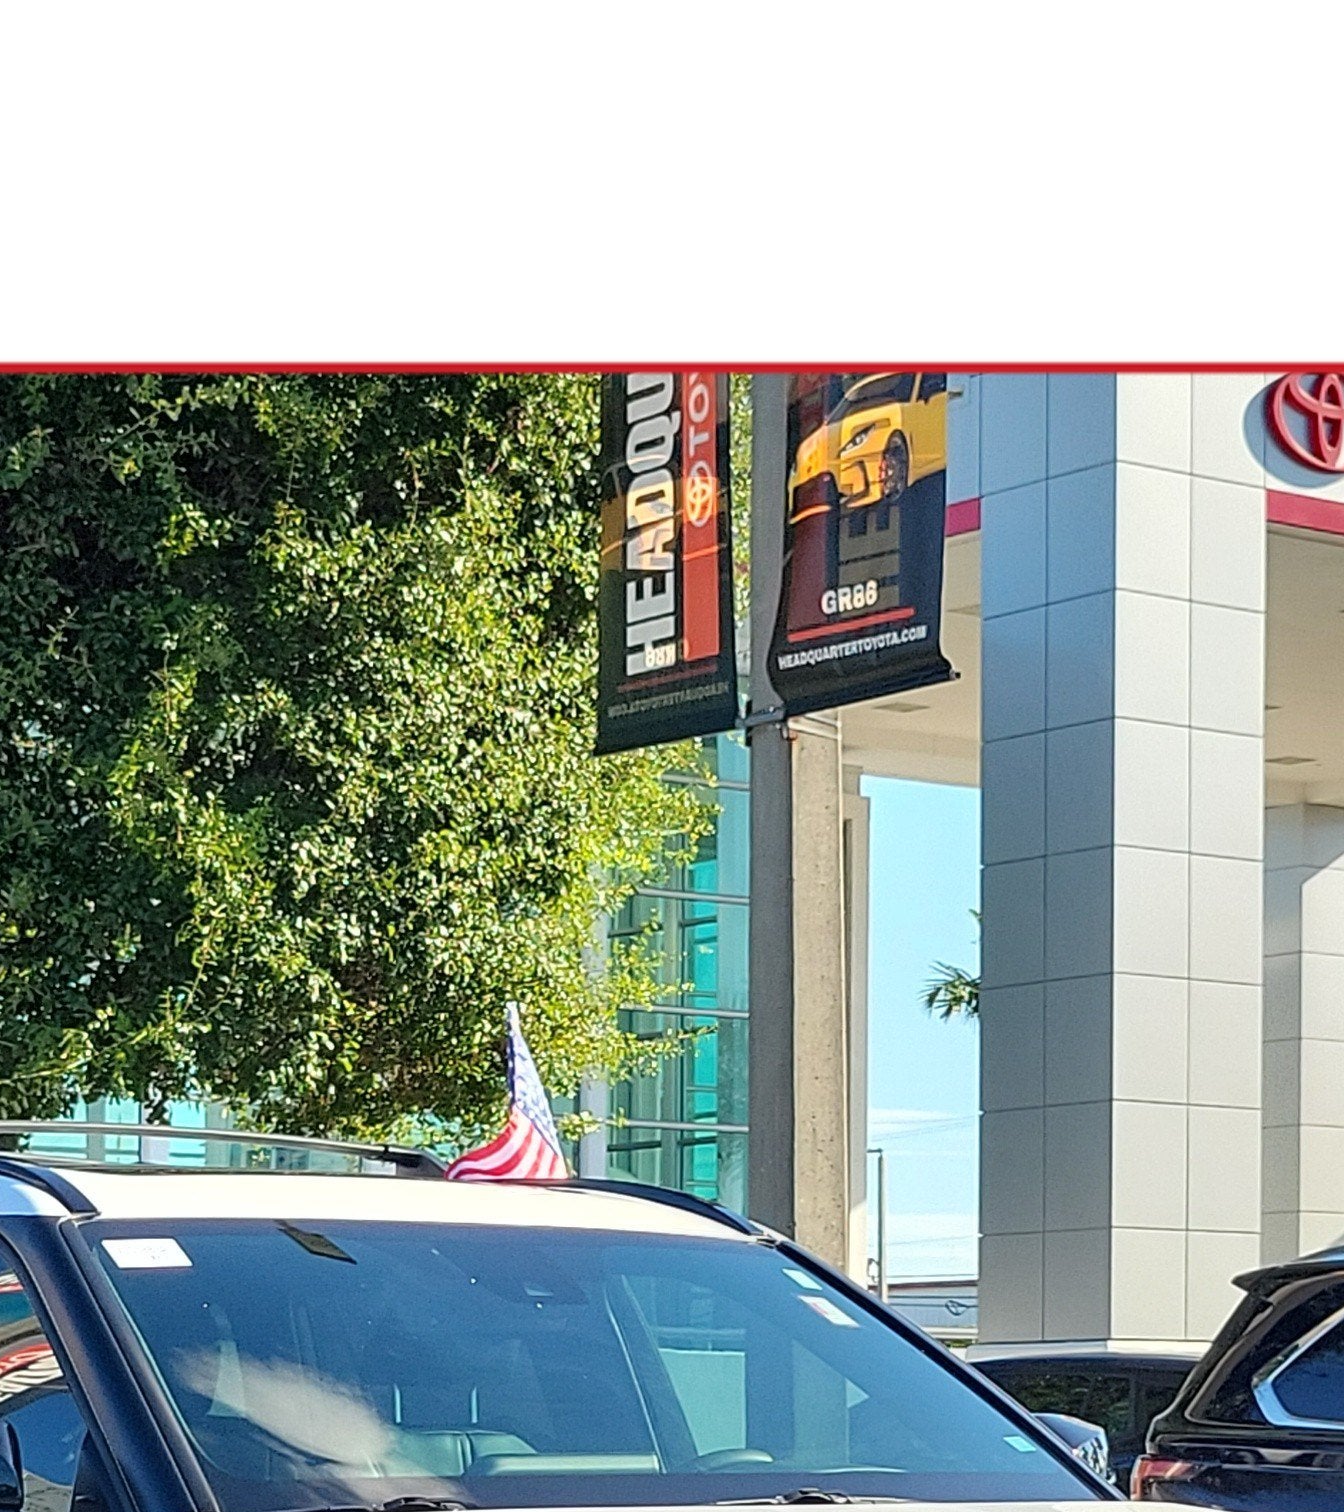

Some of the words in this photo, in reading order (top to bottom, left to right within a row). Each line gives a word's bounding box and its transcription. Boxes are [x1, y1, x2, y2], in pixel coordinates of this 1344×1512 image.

[688, 373, 711, 458] TO
[820, 578, 879, 615] GR86
[777, 625, 927, 670] HEADQUARTERTOYOTA.COM
